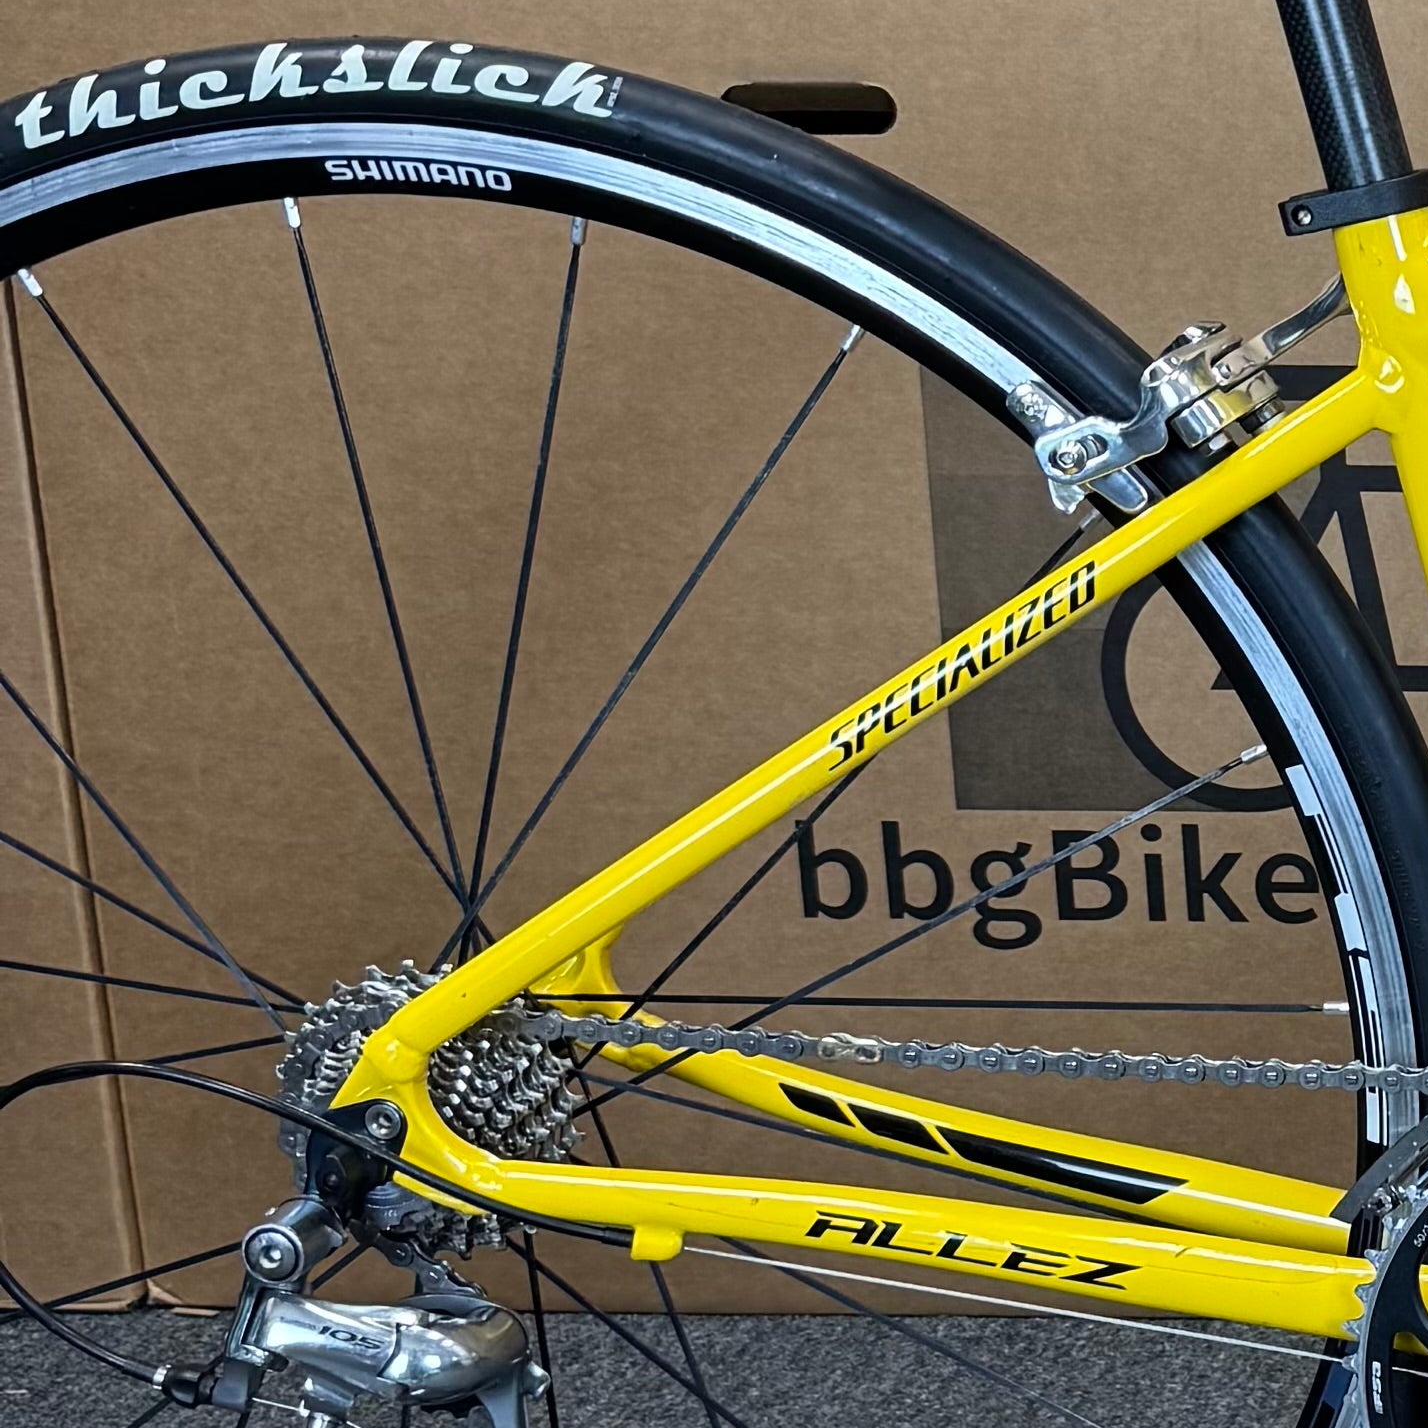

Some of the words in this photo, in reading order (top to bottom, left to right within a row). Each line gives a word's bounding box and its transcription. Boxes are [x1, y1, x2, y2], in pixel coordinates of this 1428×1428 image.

[14, 40, 613, 150] thickslick
[325, 158, 513, 193] SHIMANO
[828, 559, 1096, 772] SPECIALIZED
[803, 1210, 1145, 1291] ALLEZ
[317, 1325, 386, 1350] 105
